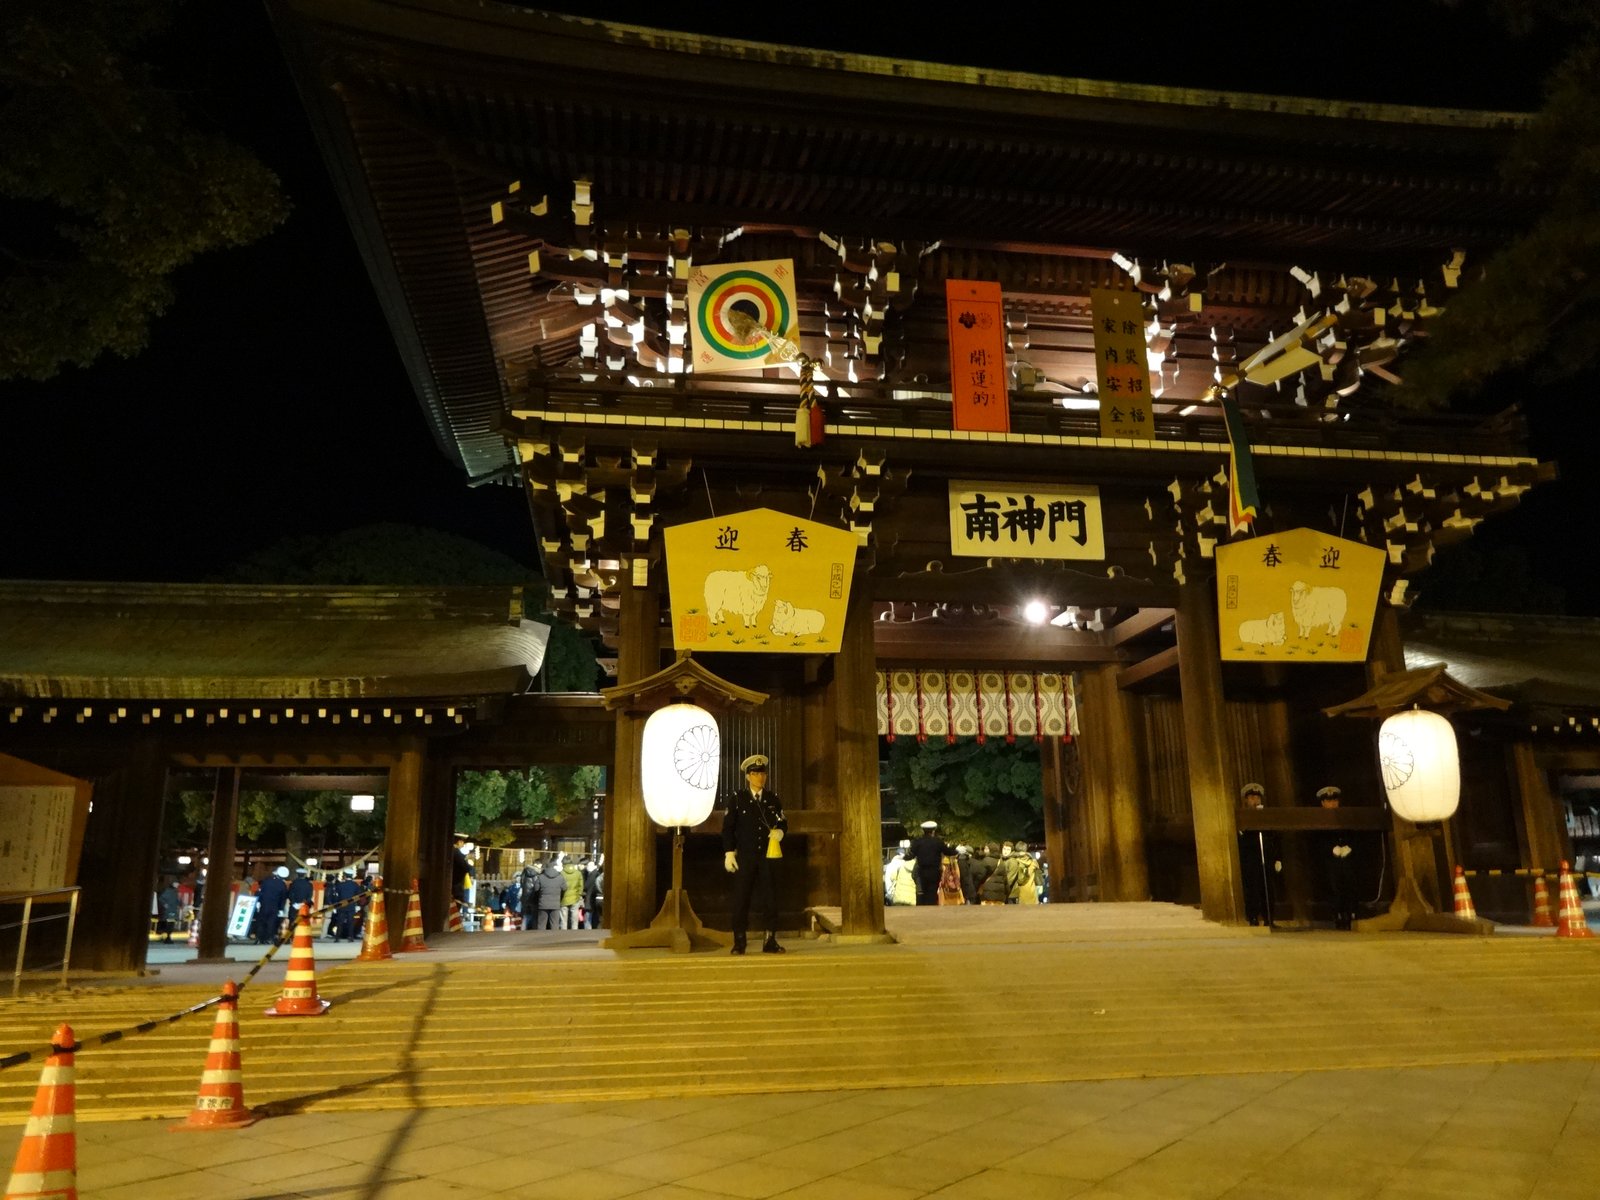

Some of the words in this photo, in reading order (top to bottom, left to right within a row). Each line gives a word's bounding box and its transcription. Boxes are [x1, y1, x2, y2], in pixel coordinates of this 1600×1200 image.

[969, 349, 989, 406] 開運的
[1101, 318, 1125, 423] 家内安全
[1121, 319, 1145, 424] 除災招福
[960, 493, 1088, 546] 南神門
